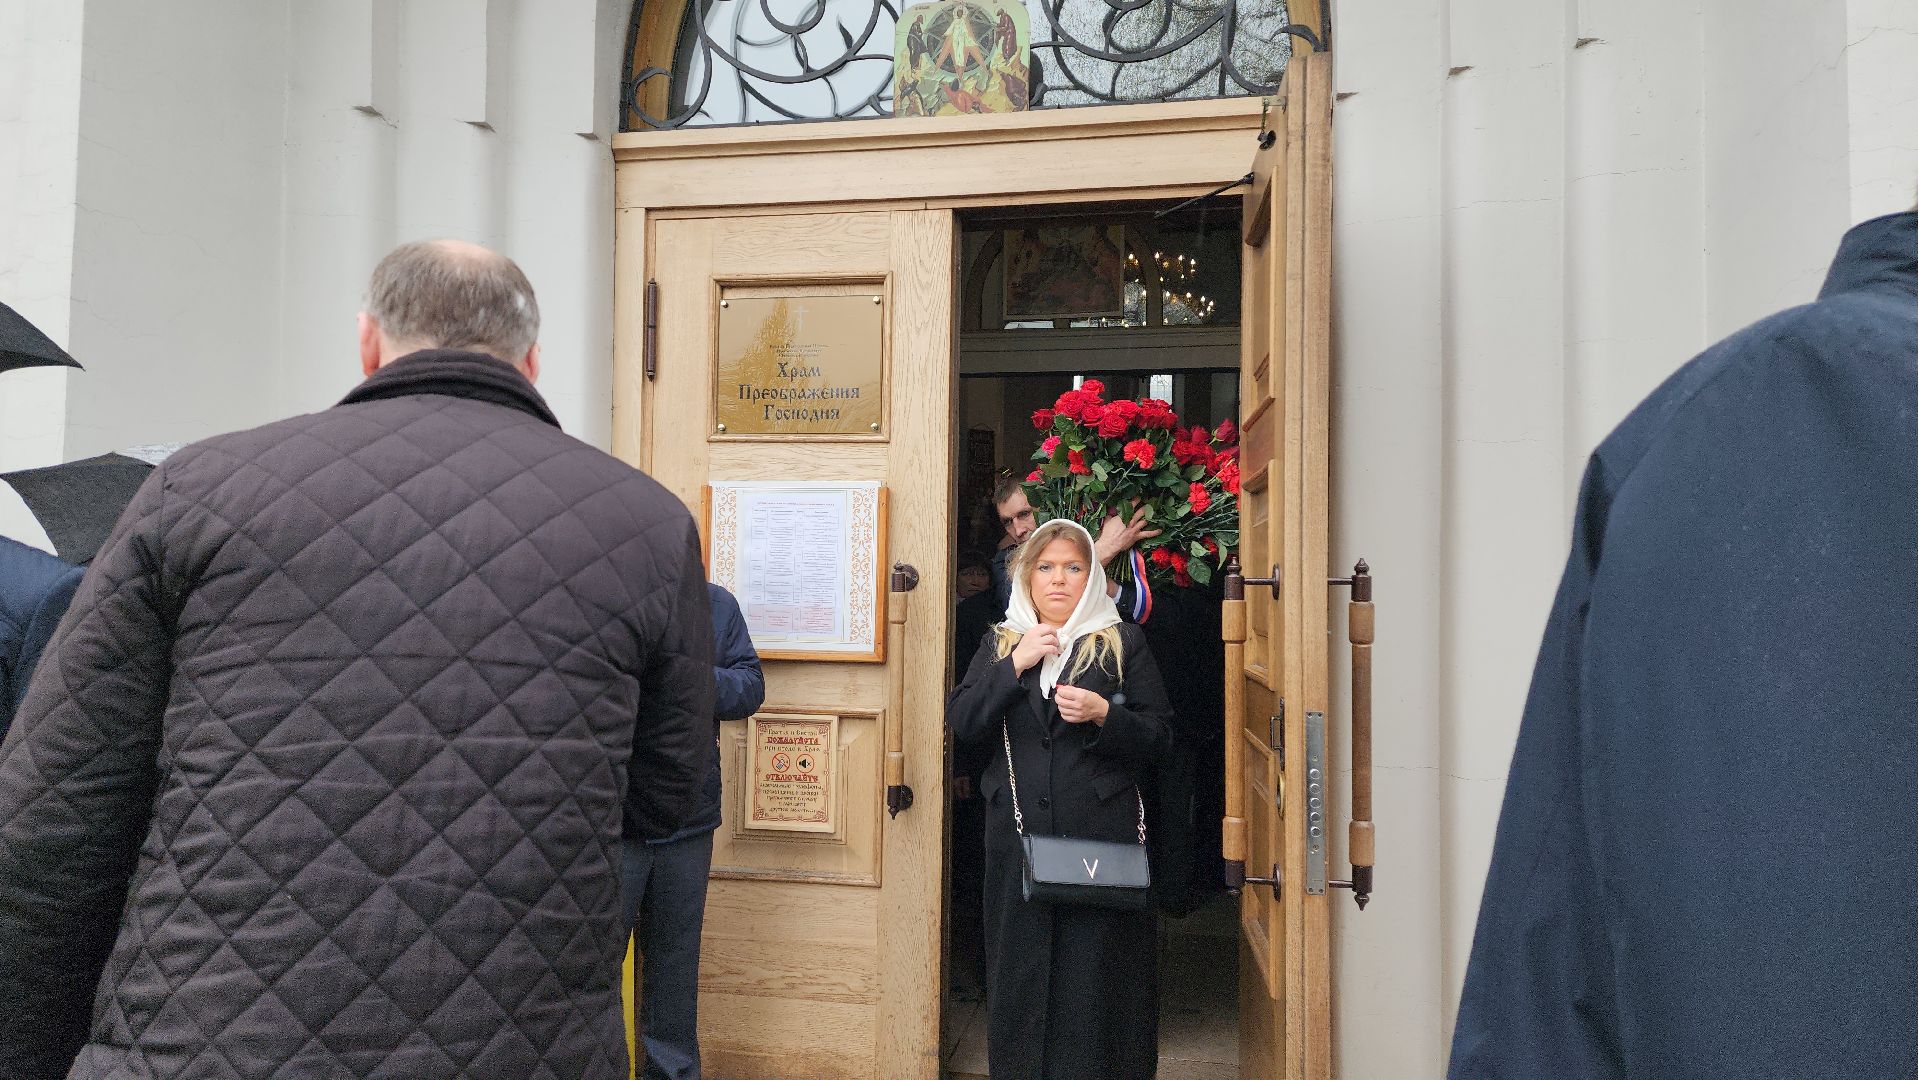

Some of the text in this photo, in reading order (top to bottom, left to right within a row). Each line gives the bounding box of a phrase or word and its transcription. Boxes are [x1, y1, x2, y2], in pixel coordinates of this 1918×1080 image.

[777, 362, 821, 382] Храм
[738, 383, 860, 405] Преображения
[763, 404, 840, 423] Господня
[1082, 858, 1099, 880] V
